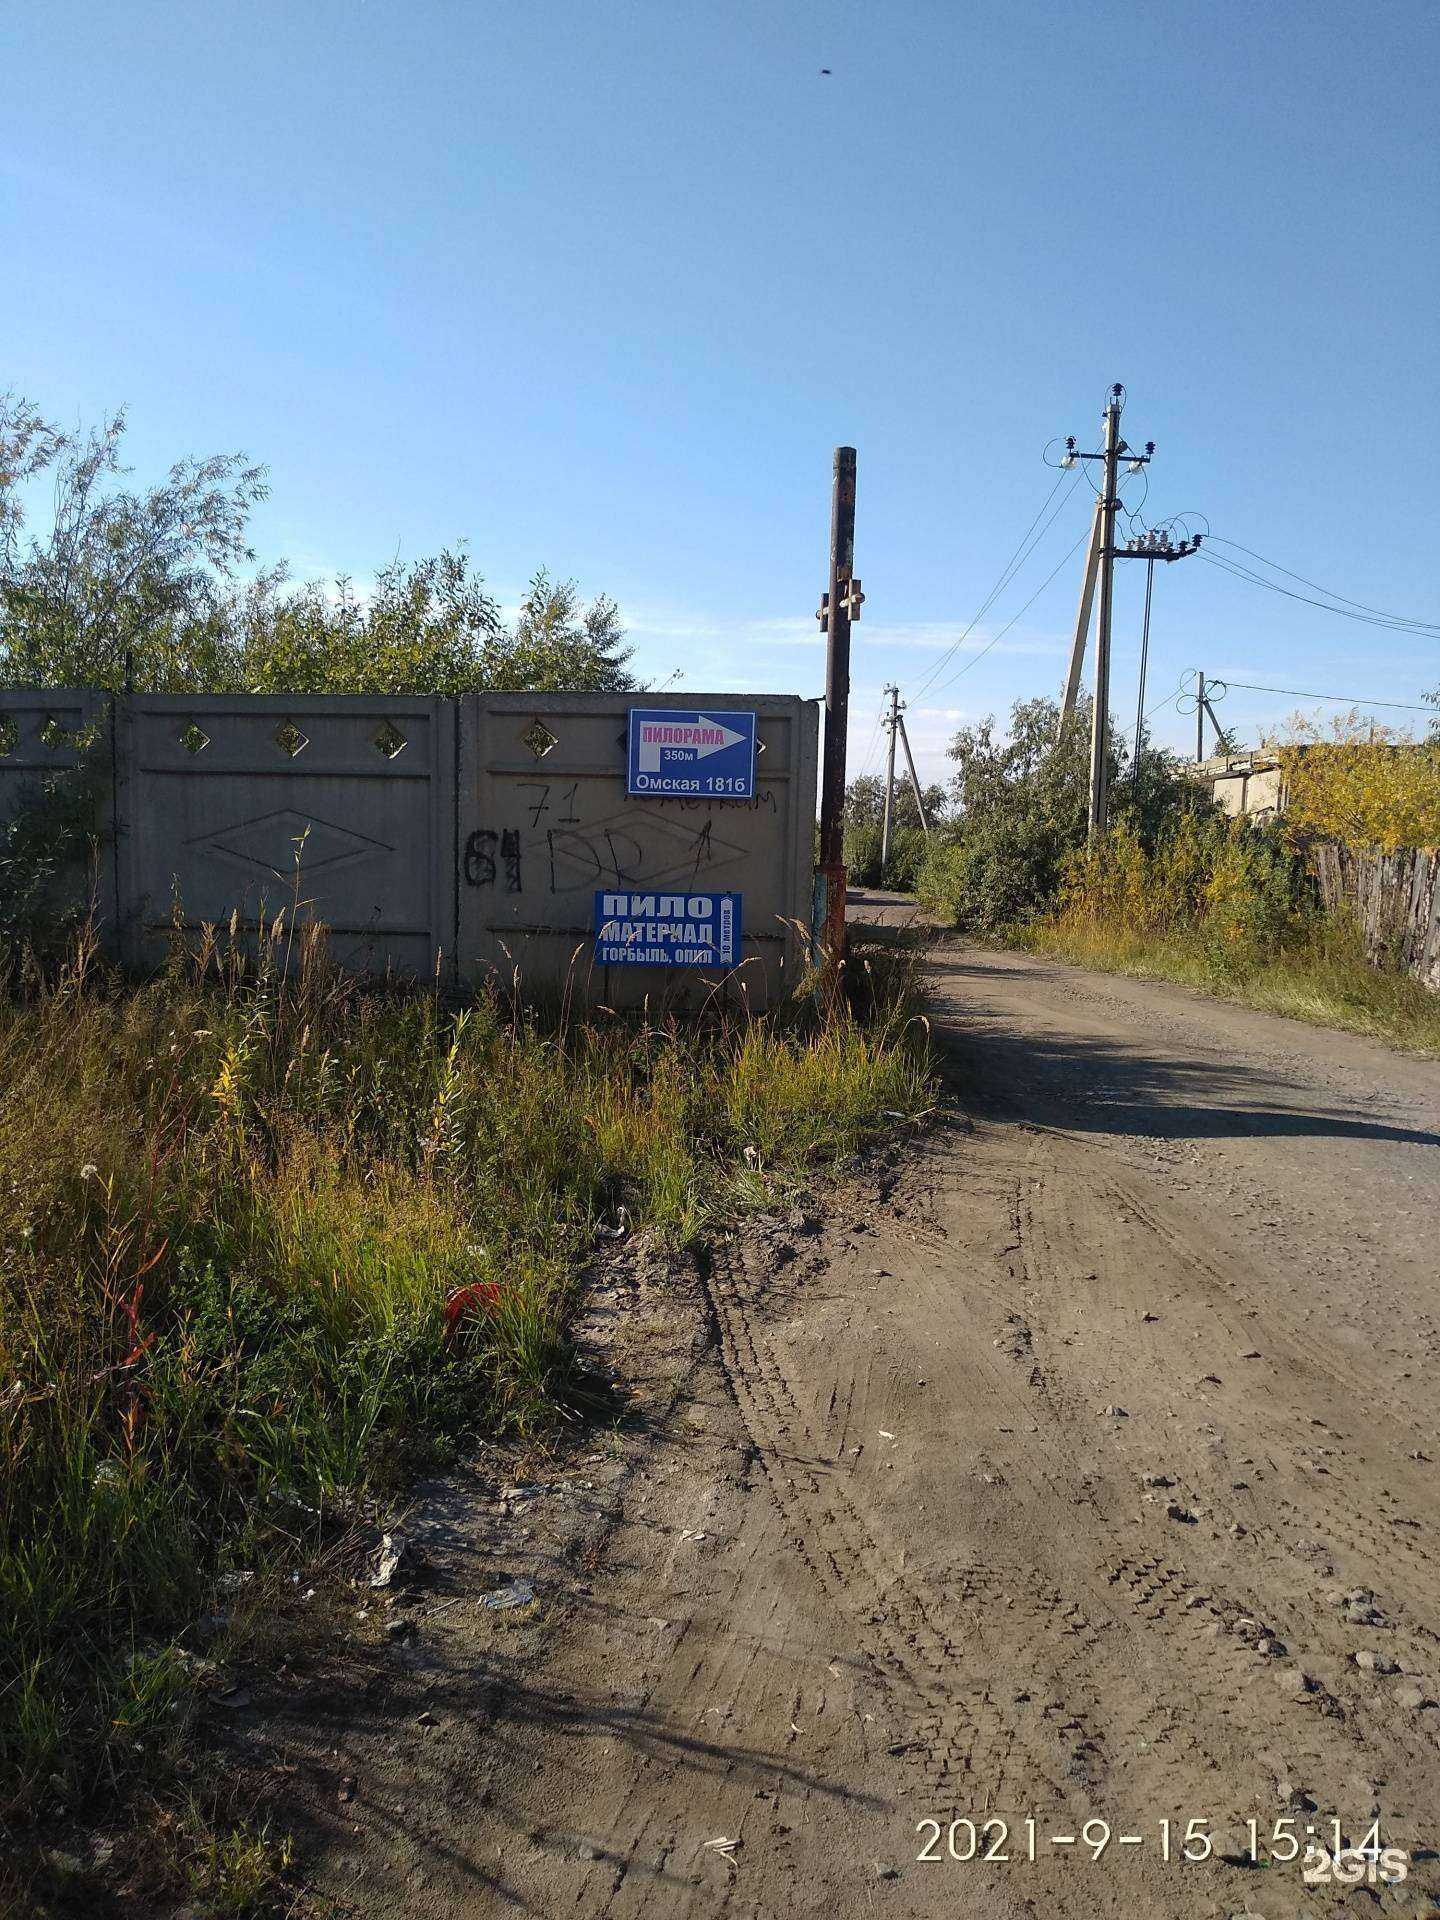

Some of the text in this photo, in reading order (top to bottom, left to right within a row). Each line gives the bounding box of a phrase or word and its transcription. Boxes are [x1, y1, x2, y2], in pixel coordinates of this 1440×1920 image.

[643, 727, 725, 745] ПИЛОРАМА
[664, 750, 694, 761] 350м
[636, 775, 700, 791] Омская
[603, 895, 713, 918] ПИЛО
[603, 922, 713, 944] МАТЕРИАЛ
[602, 947, 713, 964] ГОРБЫЛЬ, ОПИЛ
